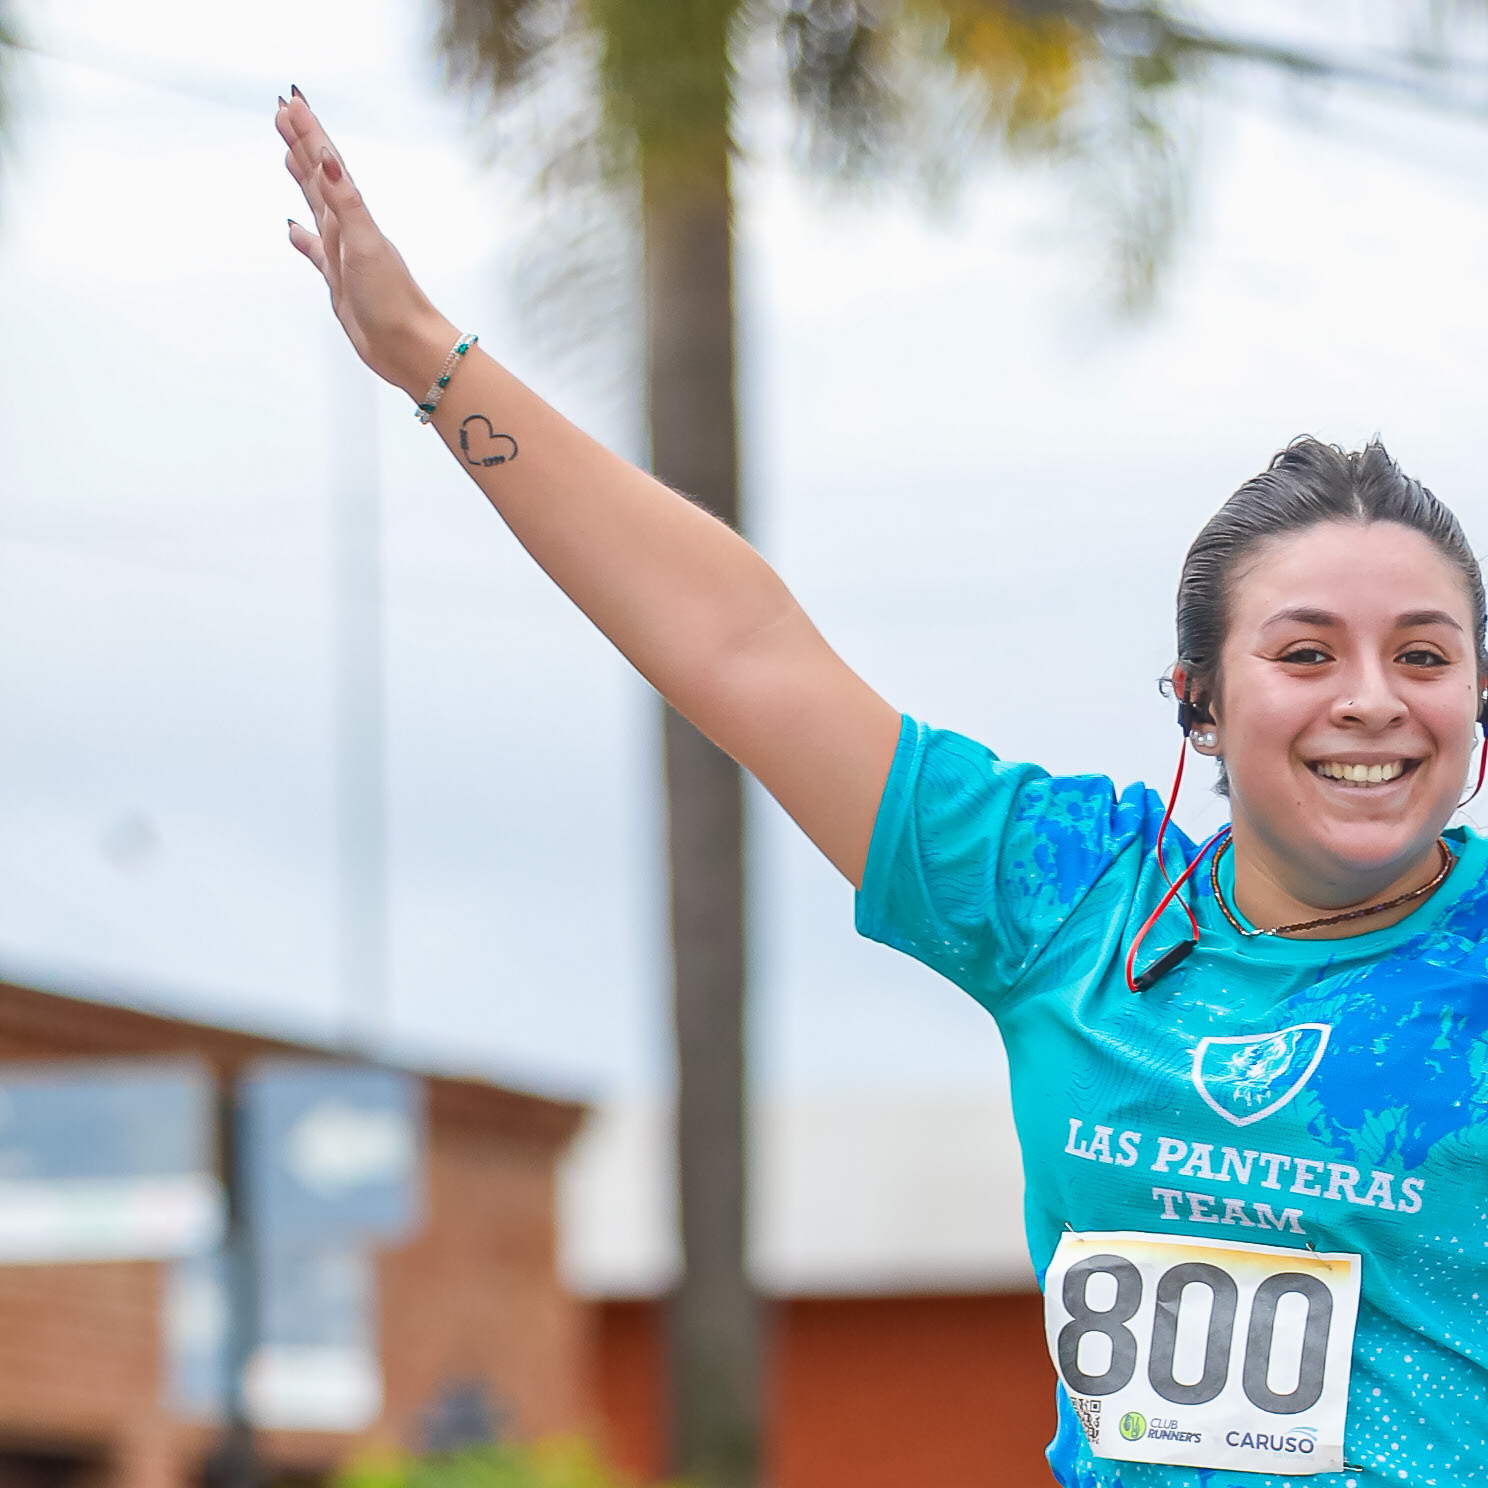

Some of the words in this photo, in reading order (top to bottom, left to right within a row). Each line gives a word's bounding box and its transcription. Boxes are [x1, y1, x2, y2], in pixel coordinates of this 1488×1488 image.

[1065, 1118, 1141, 1167] LAS
[1151, 1137, 1424, 1213] PANTERAS
[1153, 1187, 1307, 1234] TEAM
[1057, 1254, 1334, 1414] 800
[1147, 1428, 1202, 1444] RUNNER'S
[1150, 1418, 1178, 1430] CLUB
[1226, 1431, 1314, 1454] CARUSO
